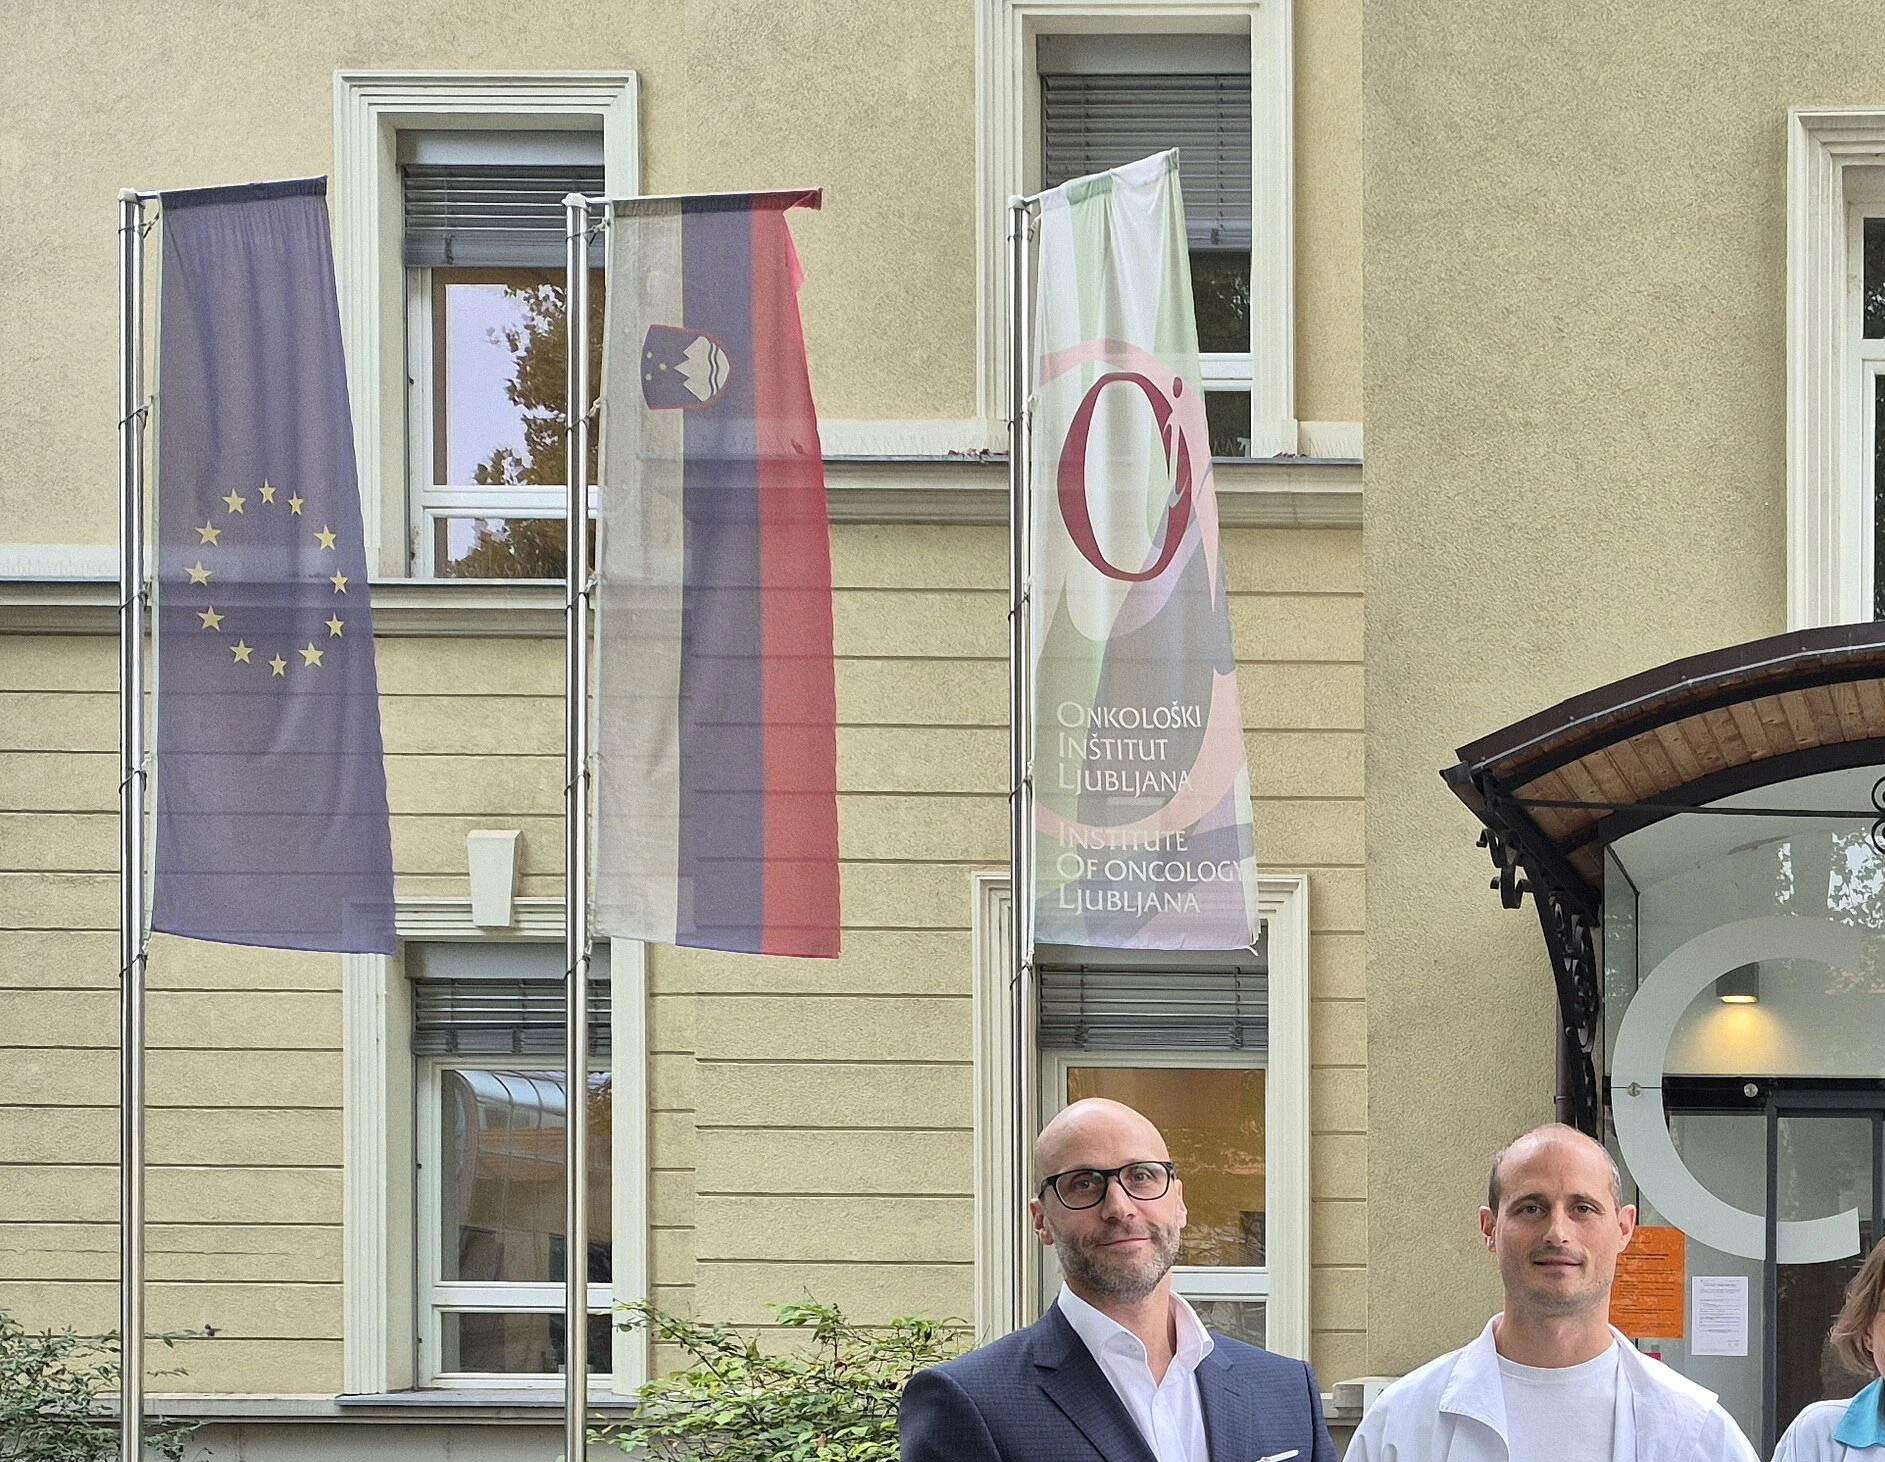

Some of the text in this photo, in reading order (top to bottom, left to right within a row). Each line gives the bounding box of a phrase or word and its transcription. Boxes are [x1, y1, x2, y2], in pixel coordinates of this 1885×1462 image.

[1056, 700, 1202, 729] ONKOLOŠKI
[1058, 732, 1169, 762] INŠTITUT
[1058, 763, 1194, 798] LJUBLJANA
[1058, 821, 1189, 852] INSTITUTE
[1056, 852, 1098, 880] OF
[1058, 883, 1202, 918] LJUBLJANA
